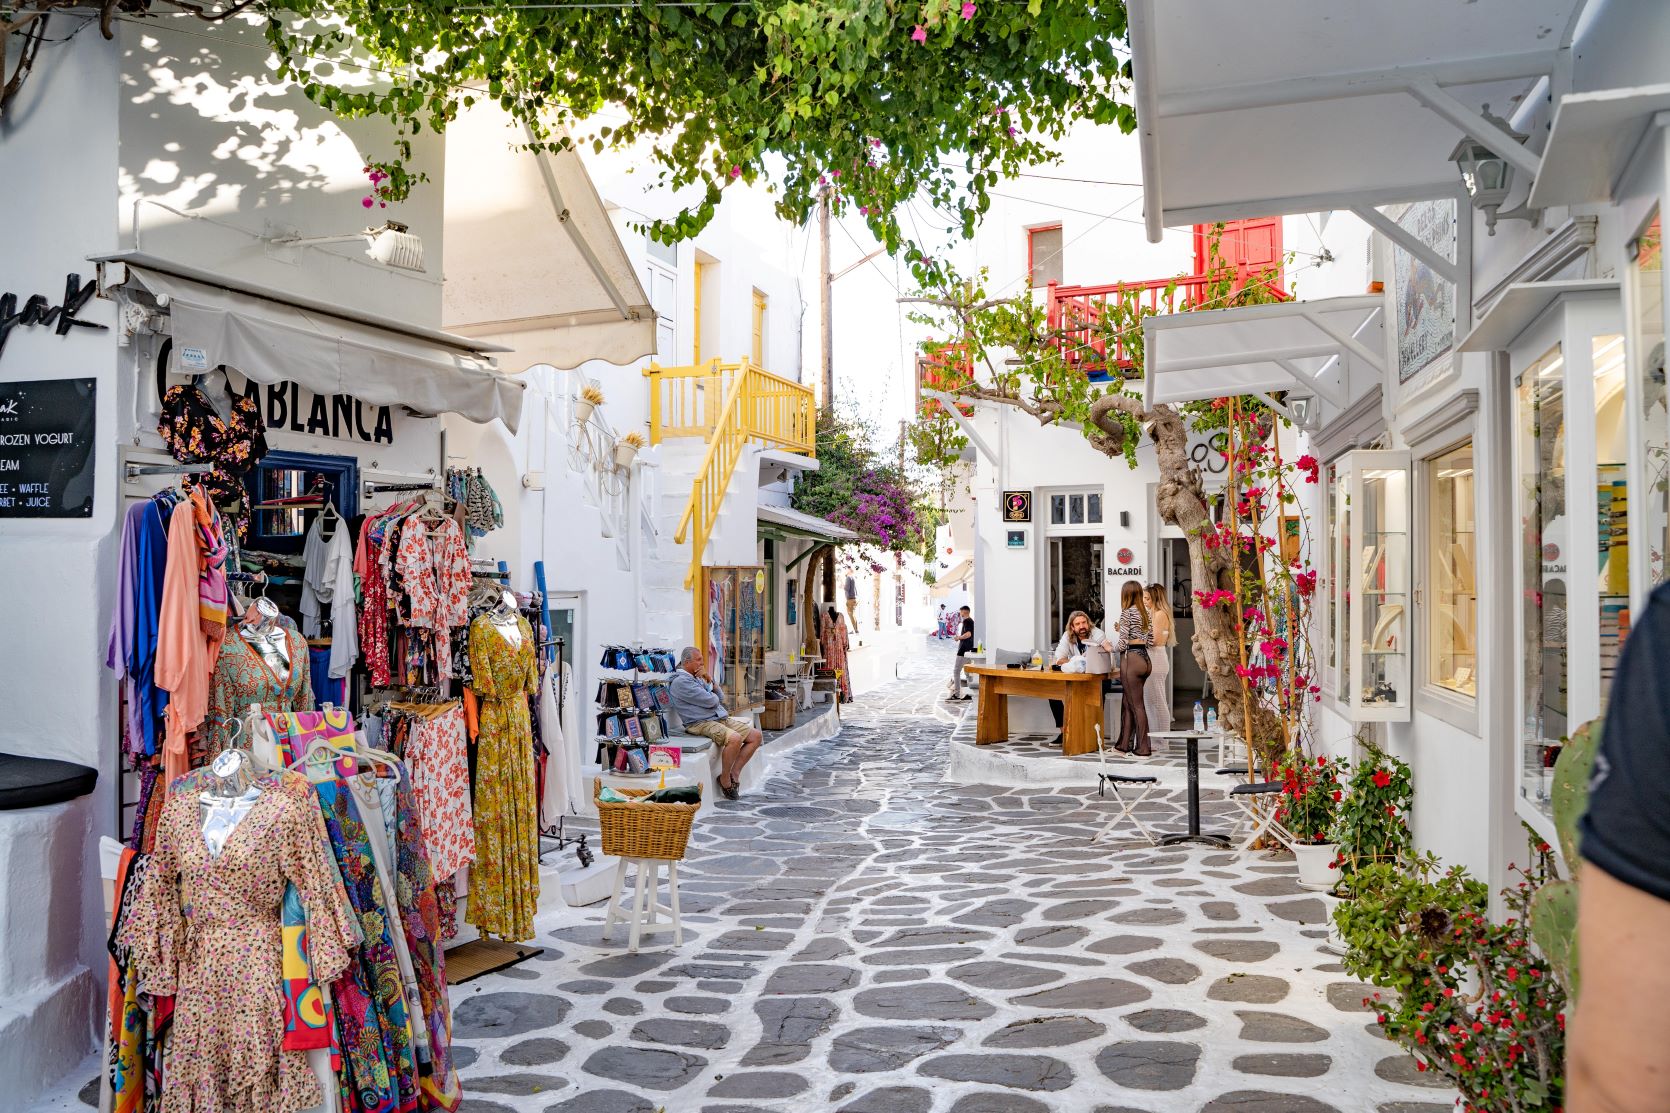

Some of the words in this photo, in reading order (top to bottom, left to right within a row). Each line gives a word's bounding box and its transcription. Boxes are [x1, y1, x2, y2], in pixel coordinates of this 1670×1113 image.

[0, 434, 31, 446] ROZEN
[35, 433, 74, 445] YOGURT
[0, 460, 20, 471] EAM
[19, 483, 49, 494] WAFFLE
[26, 497, 50, 508] JUICE
